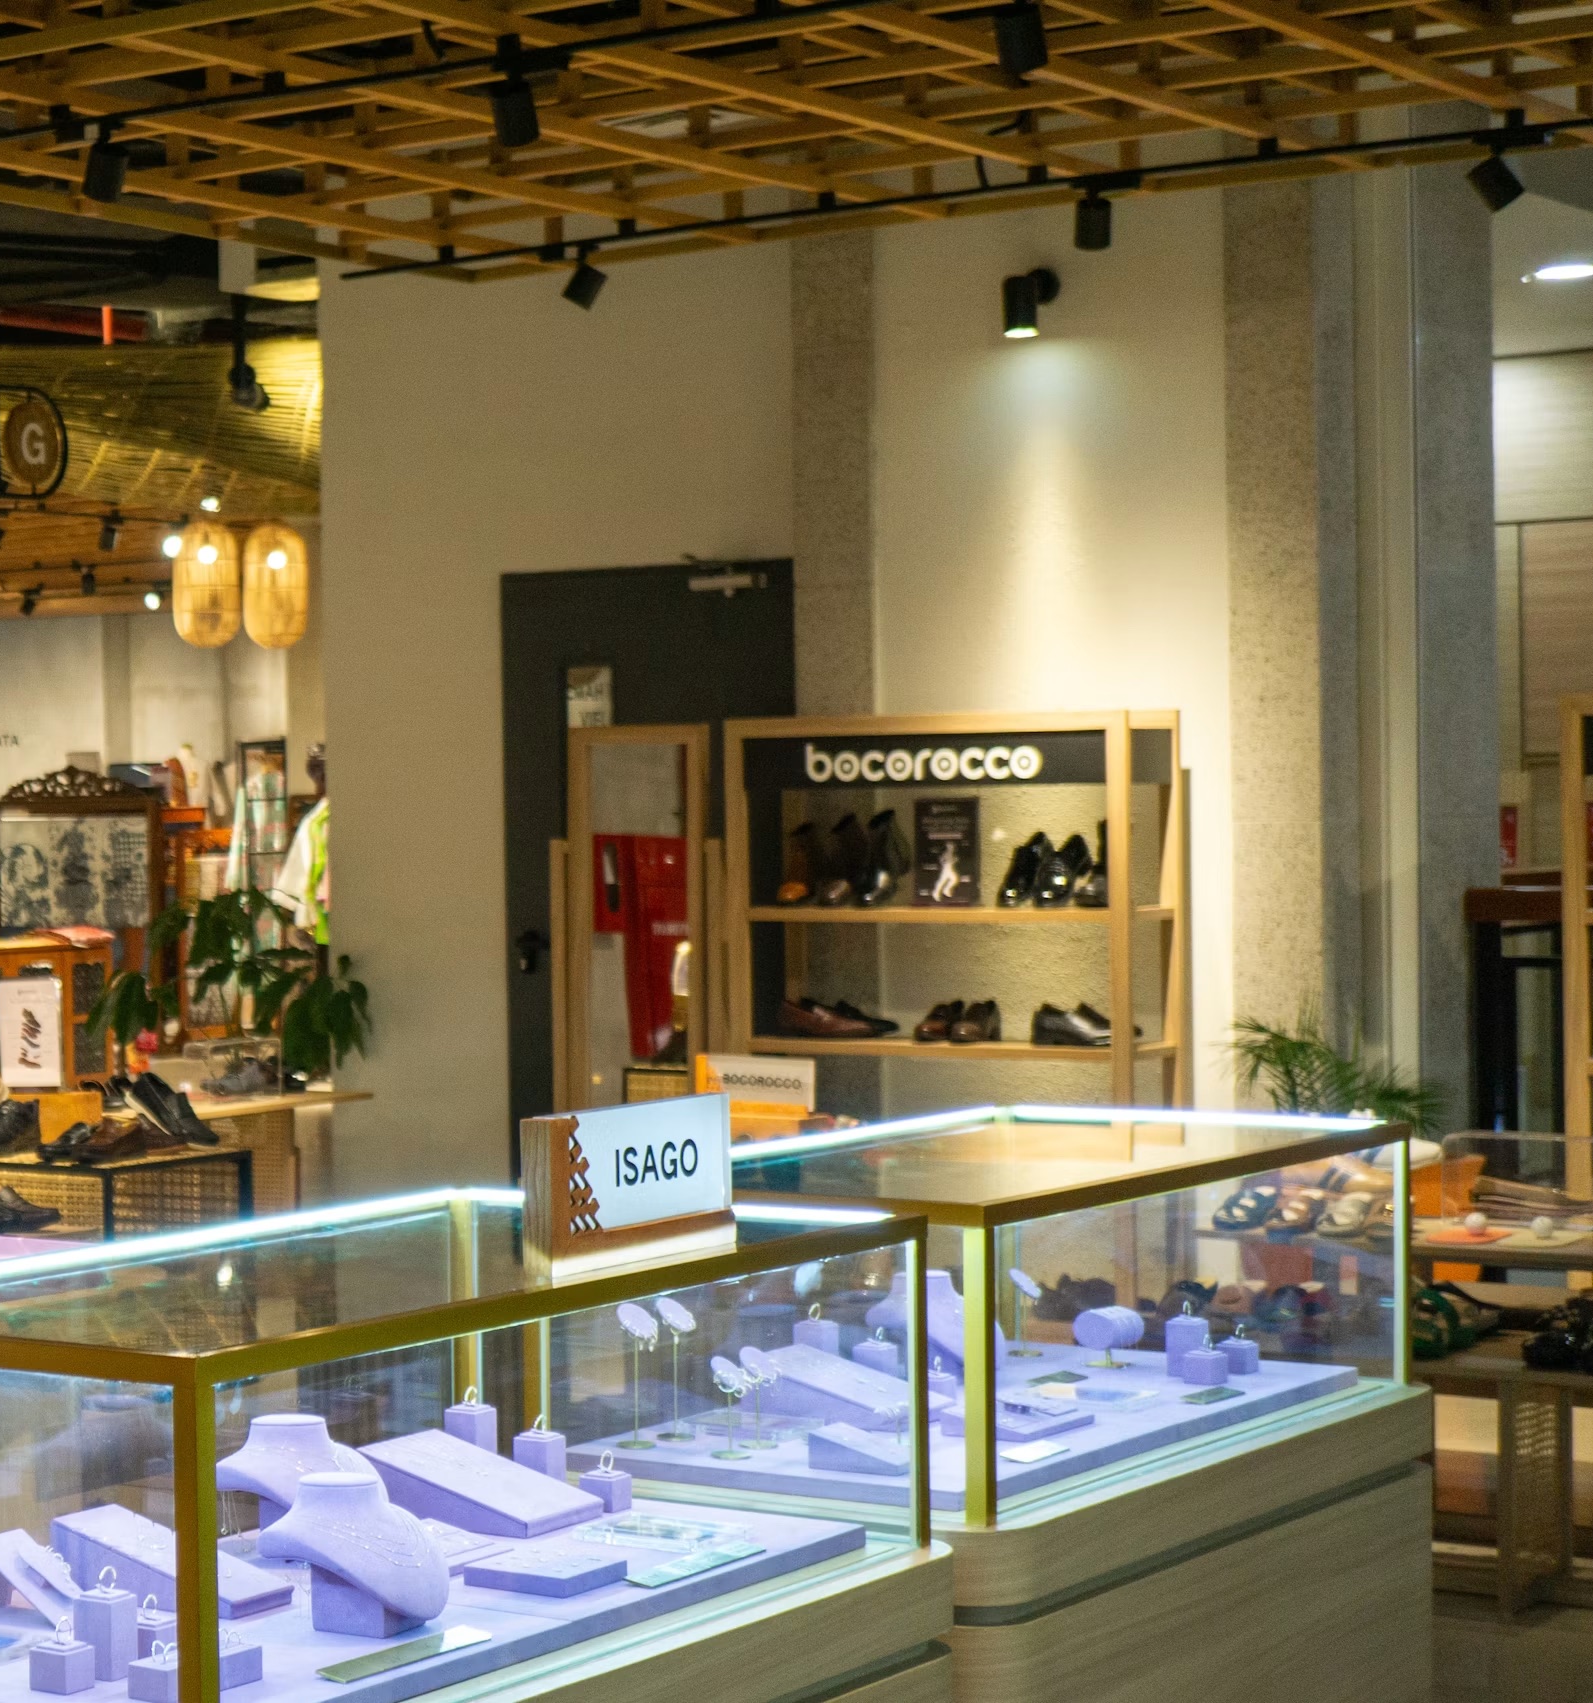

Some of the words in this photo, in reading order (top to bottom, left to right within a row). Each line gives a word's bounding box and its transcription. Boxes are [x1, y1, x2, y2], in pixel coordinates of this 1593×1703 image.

[20, 422, 46, 465] G
[805, 743, 1044, 782] bocorocco
[722, 1073, 803, 1090] BOCOROCCO
[614, 1138, 699, 1188] ISAGO
